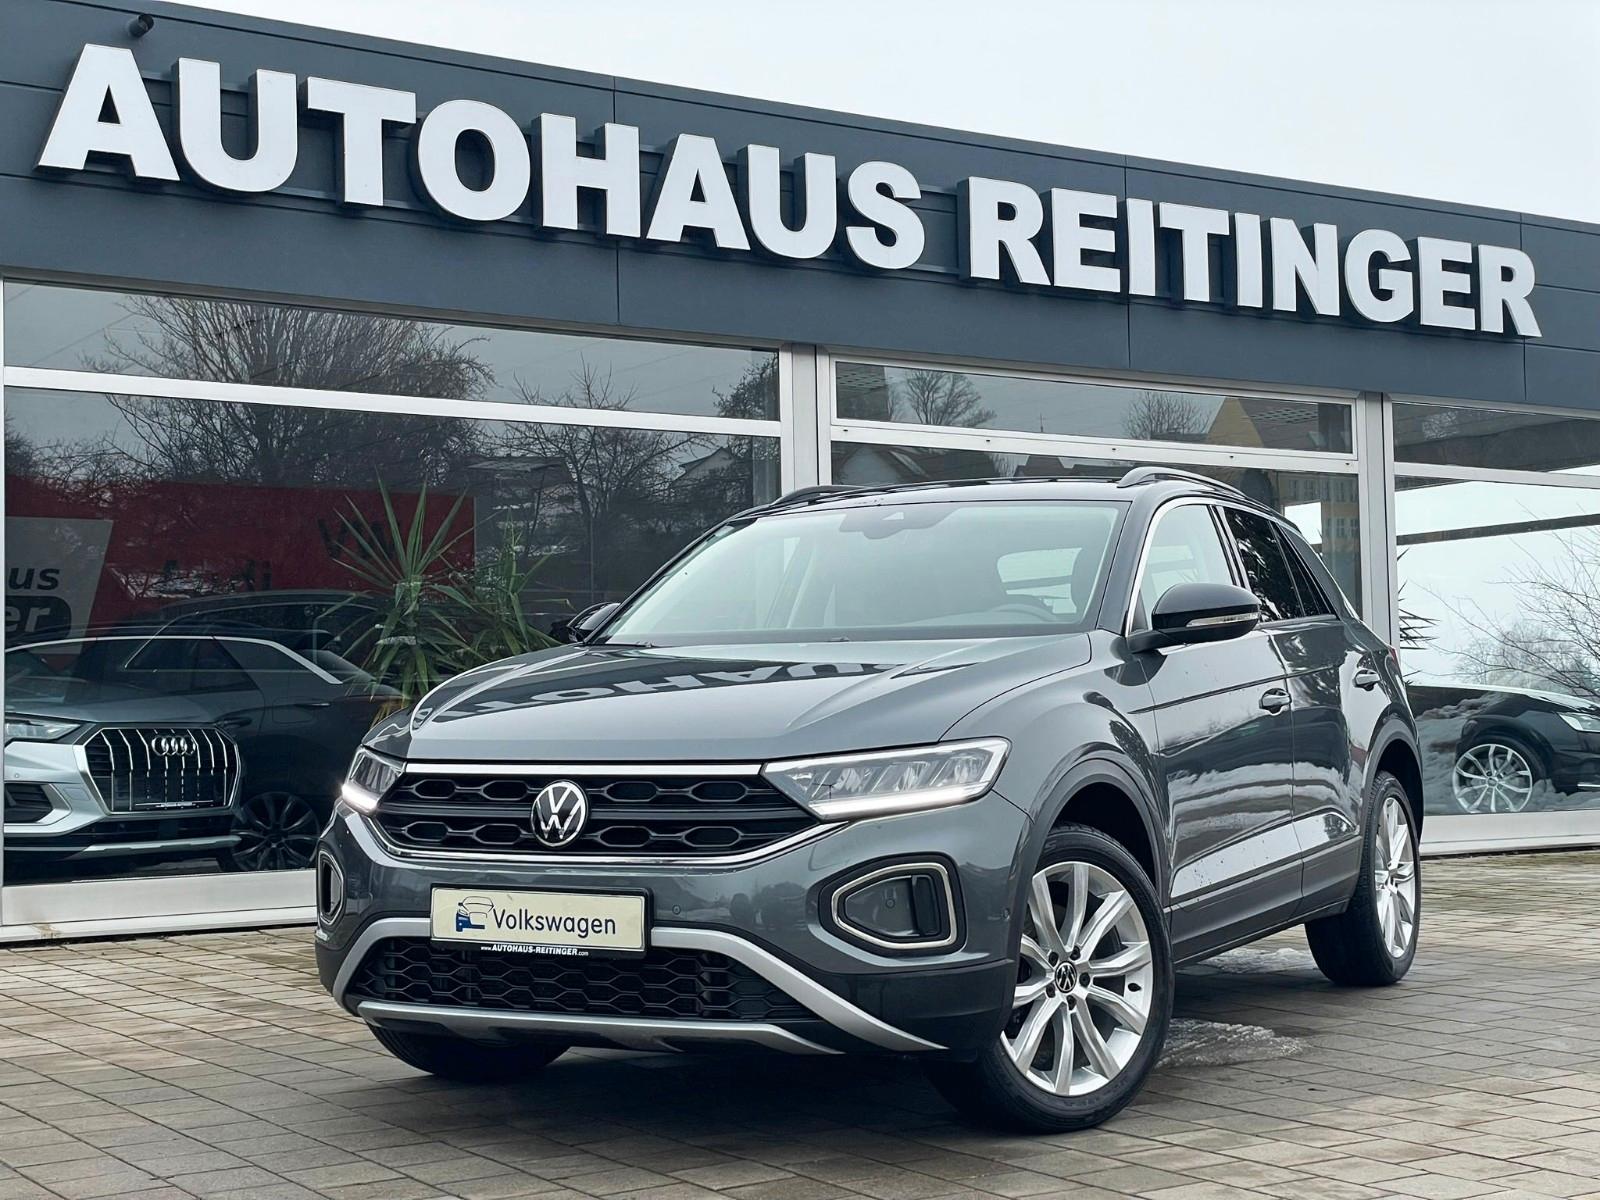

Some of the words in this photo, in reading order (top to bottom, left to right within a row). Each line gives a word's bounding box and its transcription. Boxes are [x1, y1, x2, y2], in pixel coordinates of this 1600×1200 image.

[37, 43, 926, 270] AUTOHAUS
[966, 176, 1543, 338] REITINGER
[493, 908, 616, 939] Volkswagen
